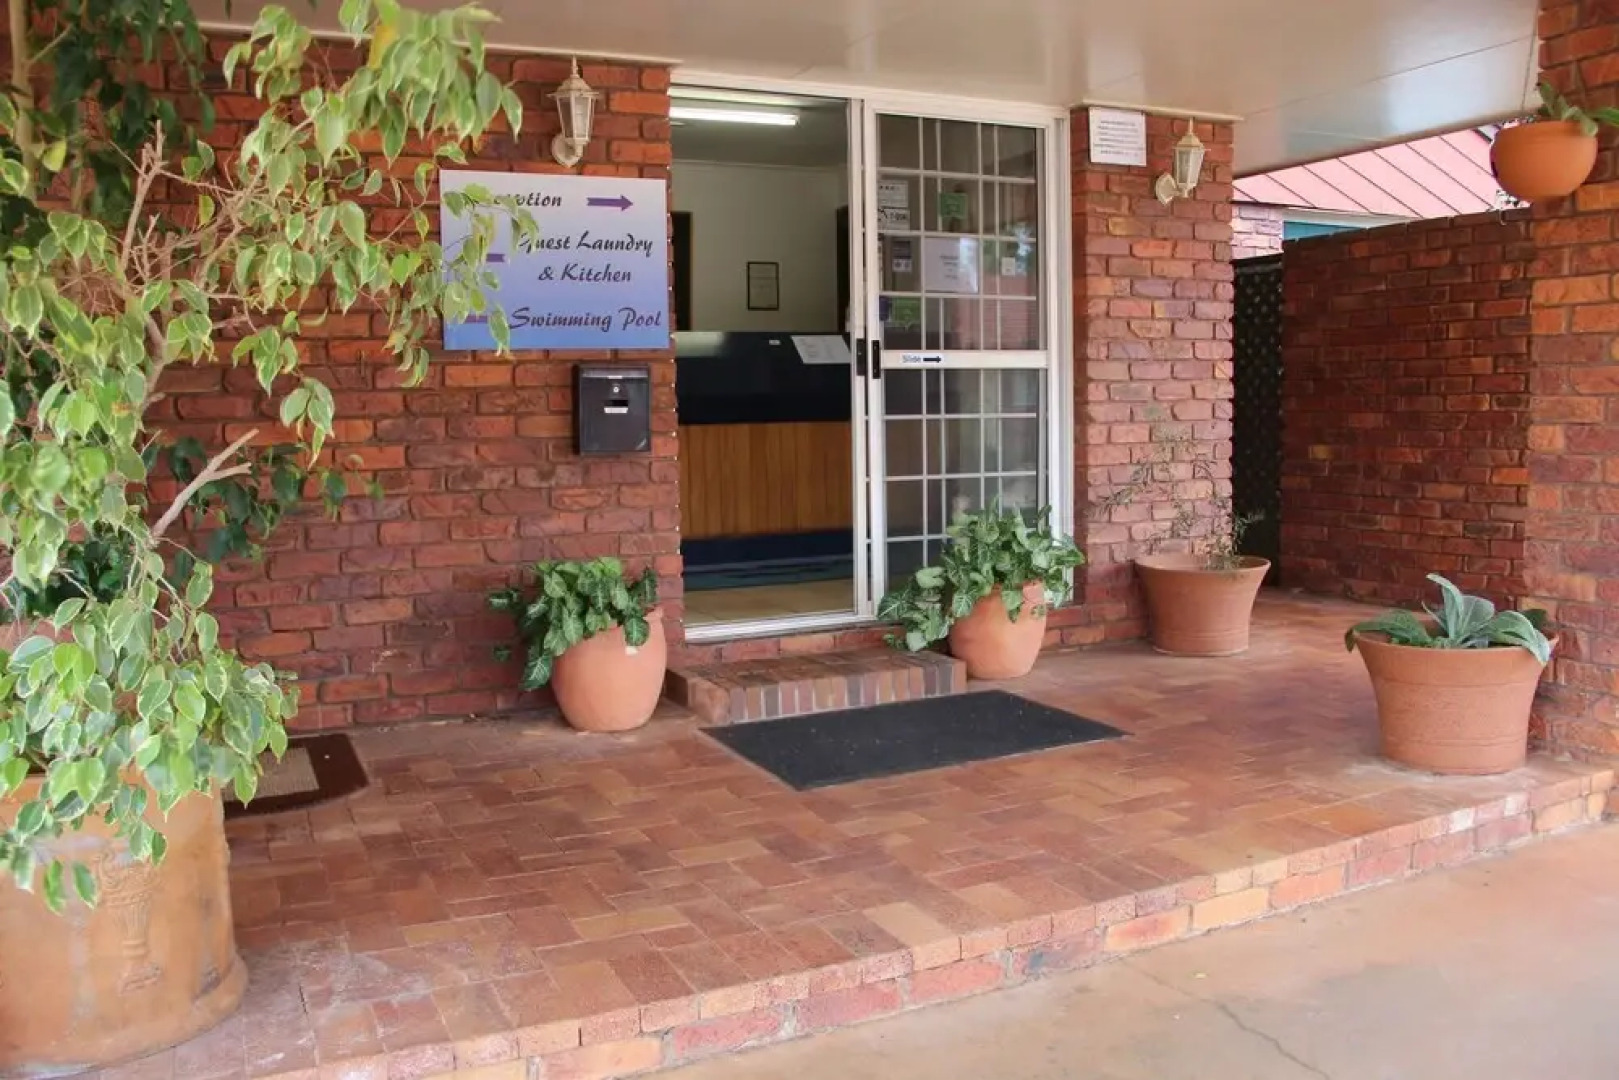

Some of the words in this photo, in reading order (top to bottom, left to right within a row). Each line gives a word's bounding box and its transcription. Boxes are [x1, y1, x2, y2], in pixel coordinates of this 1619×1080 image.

[491, 192, 563, 208] ption
[576, 229, 653, 258] Laundry
[537, 265, 555, 282] &
[560, 262, 632, 282] Kitchen
[508, 306, 613, 333] Swimming
[617, 306, 662, 331] Pool
